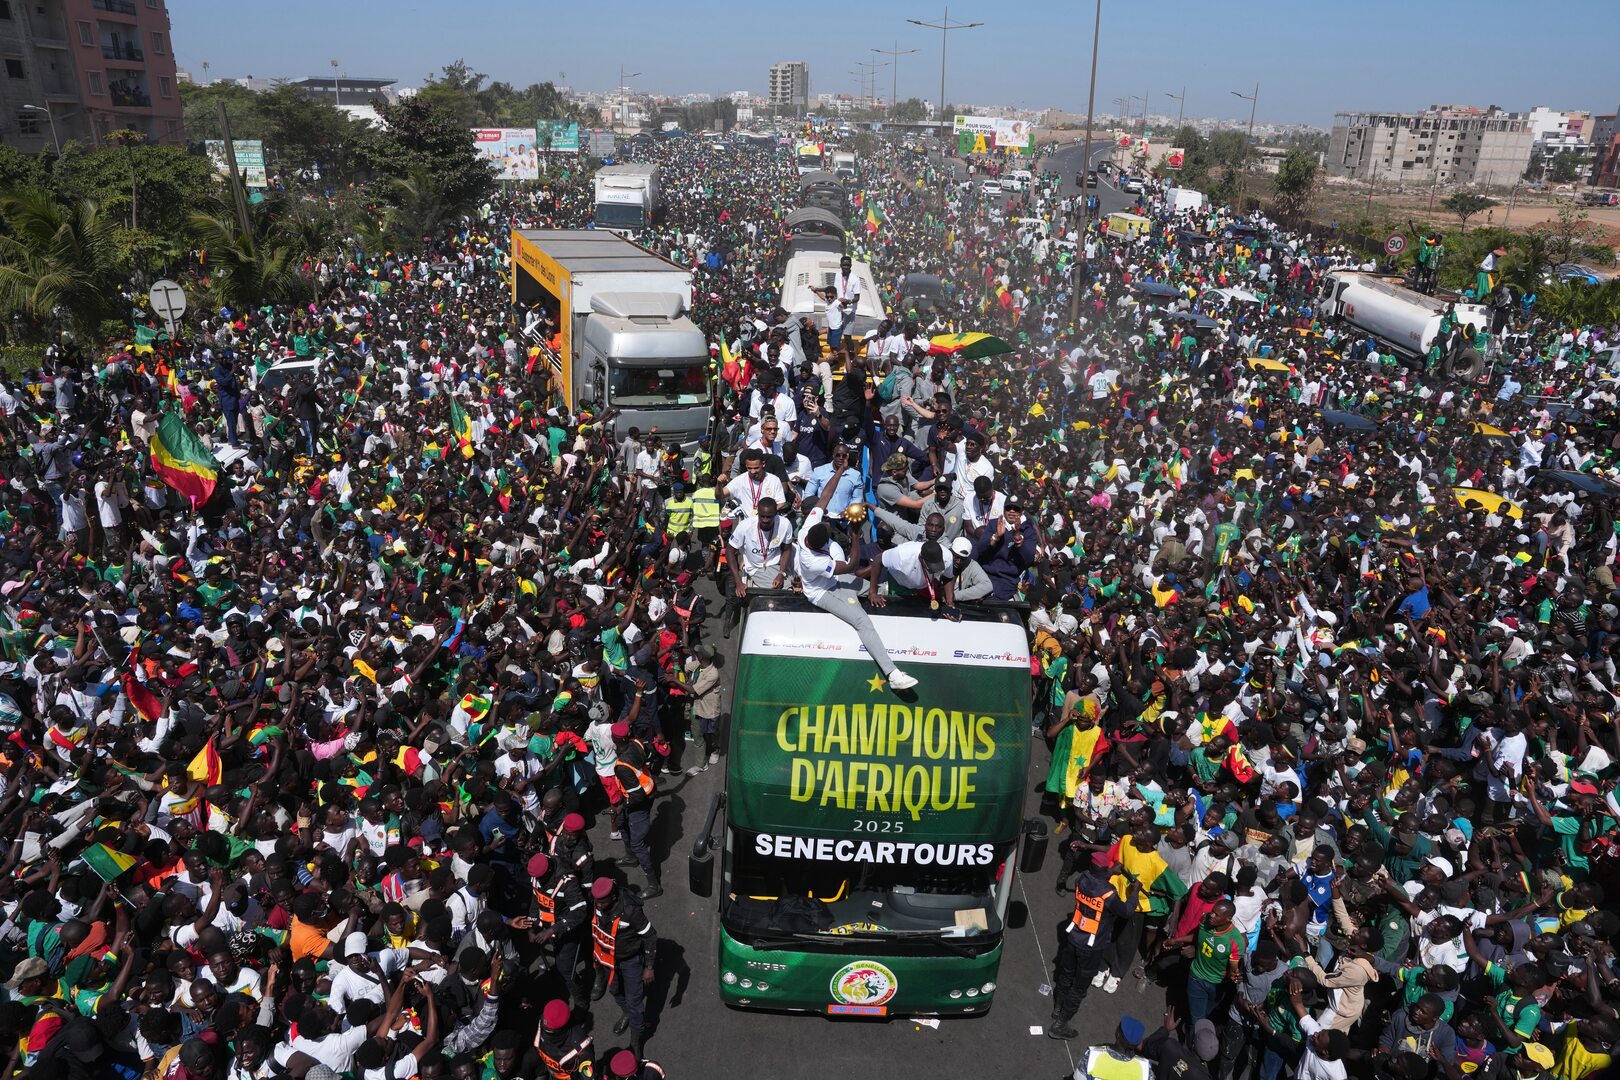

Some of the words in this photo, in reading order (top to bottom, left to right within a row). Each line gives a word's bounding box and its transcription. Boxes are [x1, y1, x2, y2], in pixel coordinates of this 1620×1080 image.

[1389, 240, 1403, 250] 90
[751, 546, 779, 556] Orge
[858, 644, 937, 657] SCARTOURS
[776, 703, 996, 761] CHAMPIONS
[790, 757, 978, 822] D'AFRIQUE
[852, 819, 904, 833] 2025
[755, 833, 995, 866] SENECARTOURS
[537, 892, 555, 909] LICE
[1077, 891, 1103, 909] POLICE
[1202, 941, 1214, 958] 13
